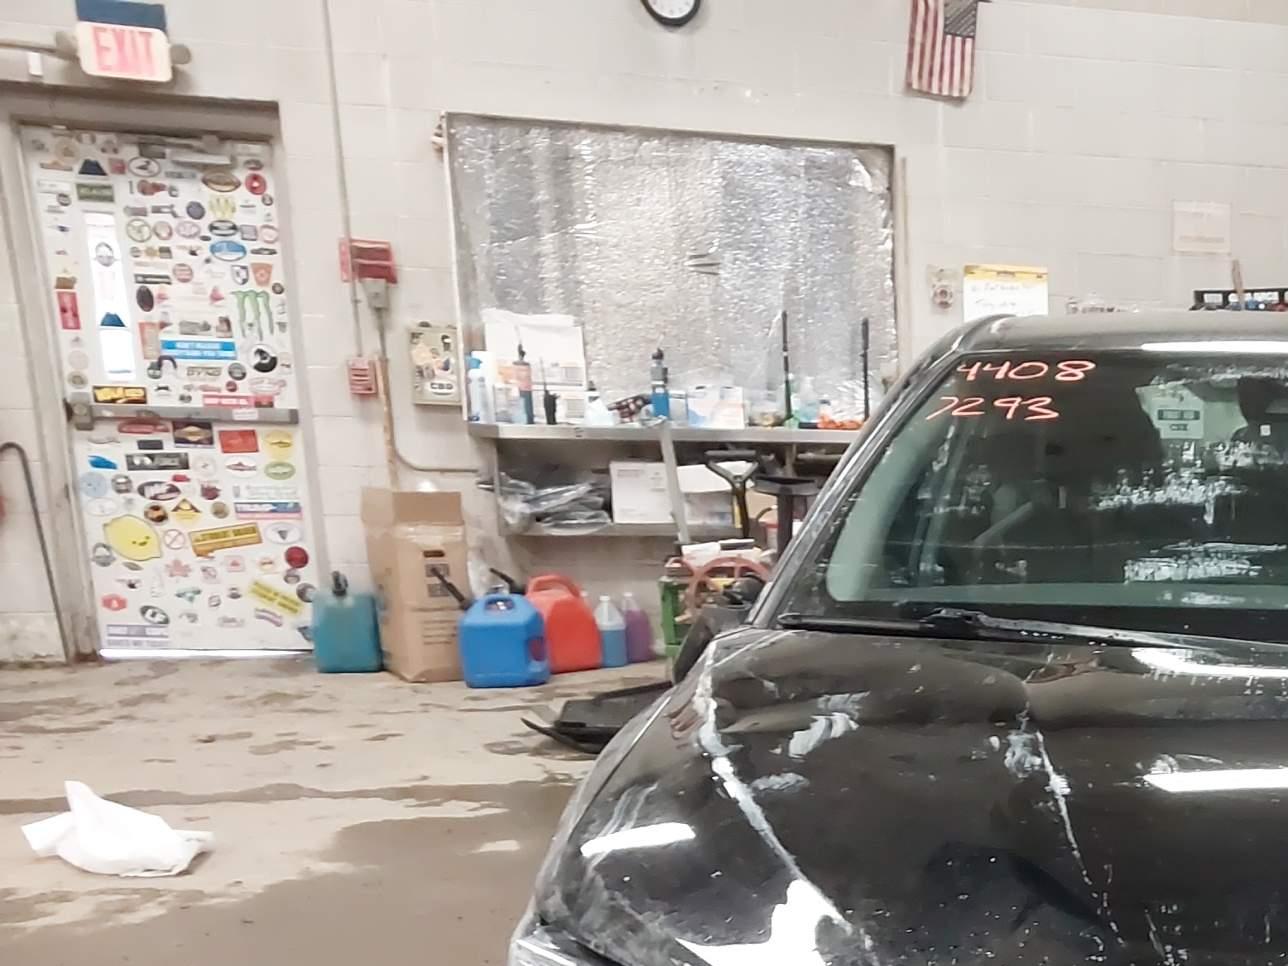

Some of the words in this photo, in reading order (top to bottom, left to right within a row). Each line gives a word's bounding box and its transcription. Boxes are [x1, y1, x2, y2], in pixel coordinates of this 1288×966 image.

[92, 26, 155, 76] EXIT
[956, 360, 1096, 381] 4408
[925, 396, 1059, 420] 7293
